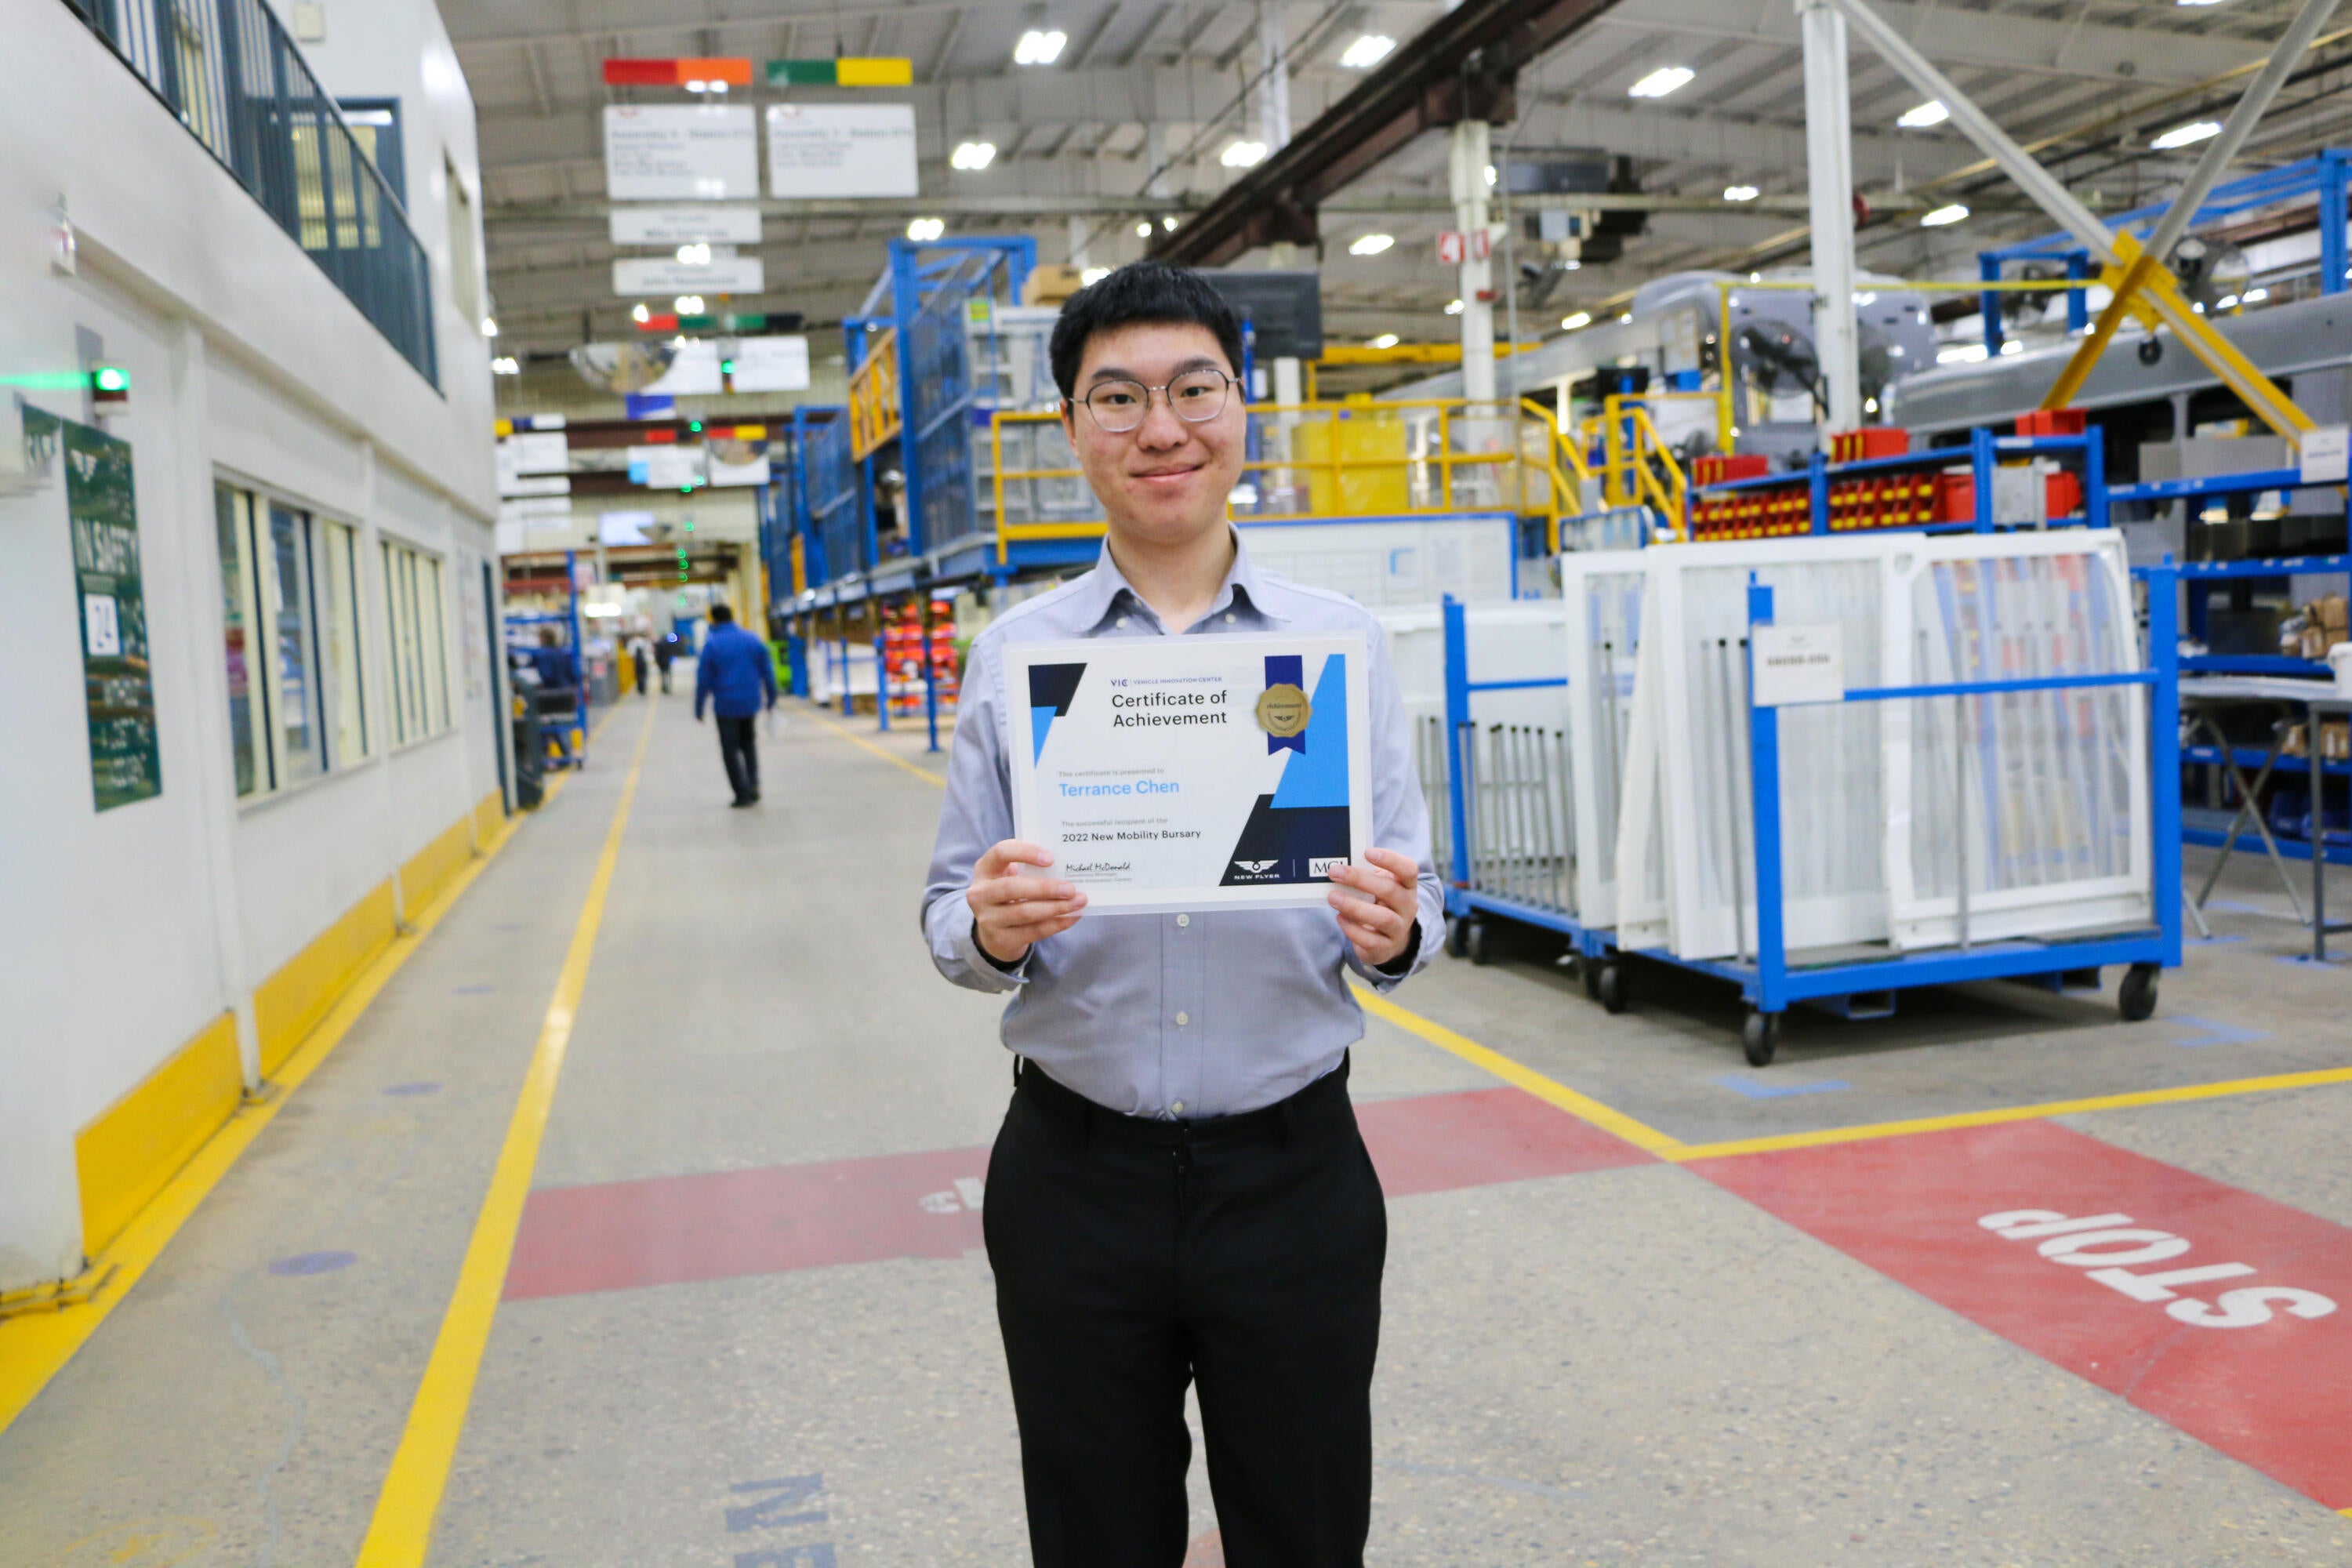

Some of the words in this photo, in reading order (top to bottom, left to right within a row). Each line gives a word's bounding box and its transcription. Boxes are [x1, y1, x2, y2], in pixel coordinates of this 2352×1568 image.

[1112, 691, 1204, 708] Certificate
[1210, 690, 1227, 704] of
[1113, 711, 1227, 728] Achievement
[1120, 768, 1156, 777] presented
[1059, 783, 1131, 797] Terrance
[1136, 779, 1180, 794] Chen
[1062, 833, 1089, 842] 2022
[1091, 833, 1114, 841] New
[1116, 830, 1159, 841] Mobility
[1162, 829, 1201, 840] Bursary
[1977, 1209, 2338, 1329] STOP
